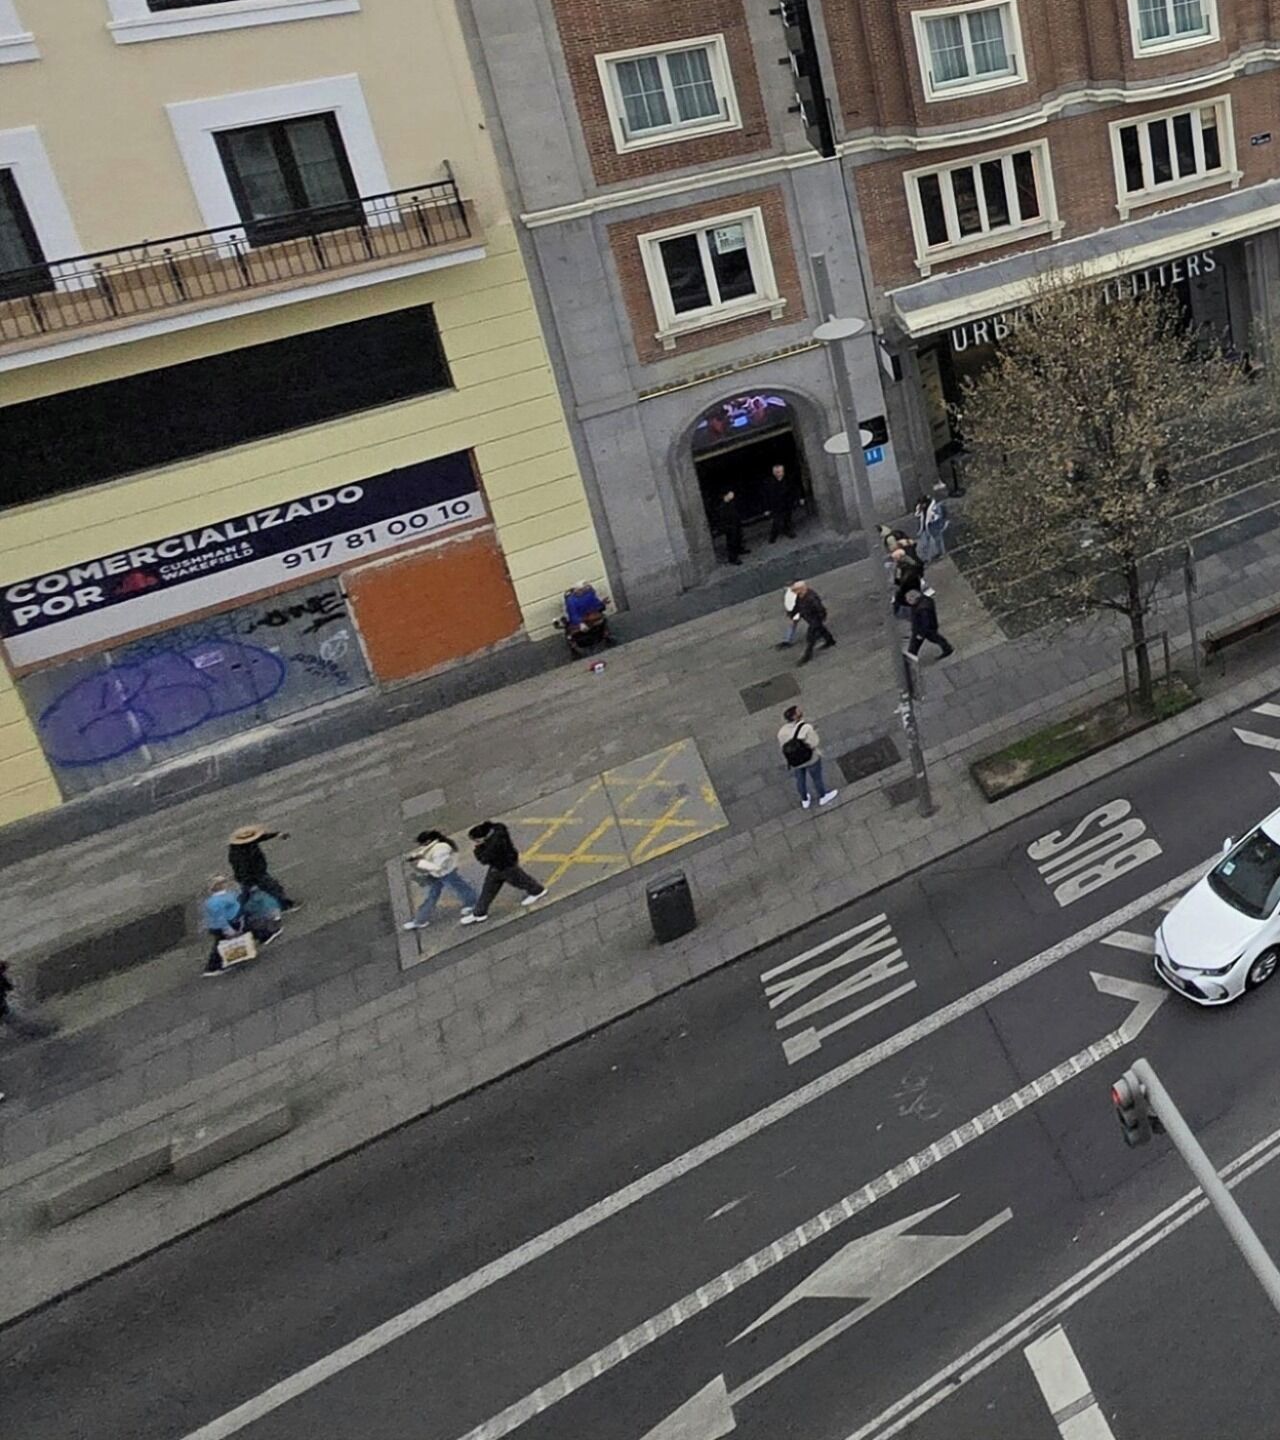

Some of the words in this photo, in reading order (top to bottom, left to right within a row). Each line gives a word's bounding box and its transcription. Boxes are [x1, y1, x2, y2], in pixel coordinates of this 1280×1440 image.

[5, 485, 364, 604] COMERCIALIZADO
[159, 544, 238, 574] CUSHMAN
[161, 548, 254, 582] WAKEFIELD
[282, 542, 334, 569] 917
[346, 529, 377, 550] 81
[388, 513, 428, 536] 00
[437, 500, 470, 520] 10
[12, 586, 105, 627] POR
[1027, 798, 1163, 908] BUS
[760, 913, 918, 1066] TAXI
